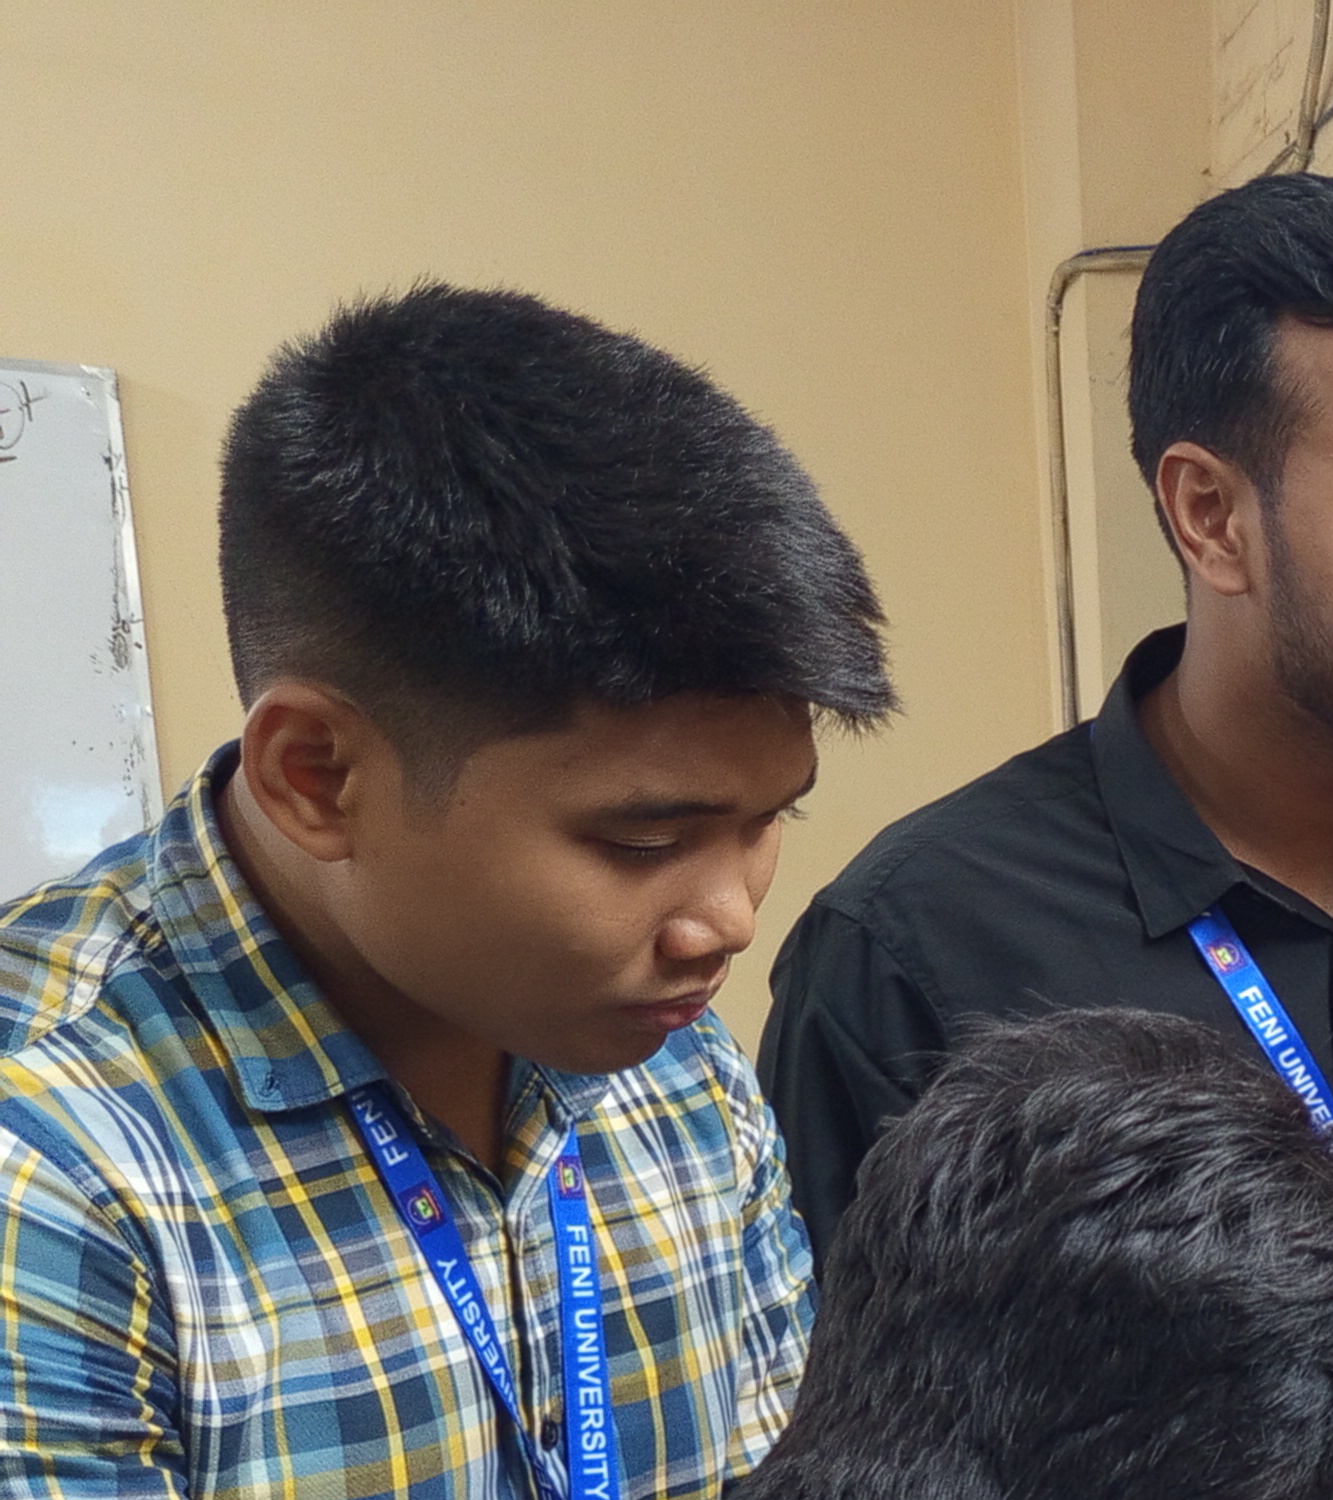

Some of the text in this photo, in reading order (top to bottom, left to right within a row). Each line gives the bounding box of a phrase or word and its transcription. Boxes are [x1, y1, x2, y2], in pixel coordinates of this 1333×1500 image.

[1237, 985, 1288, 1047] FENI
[352, 1091, 409, 1167] FENI
[566, 1224, 590, 1298] FENI
